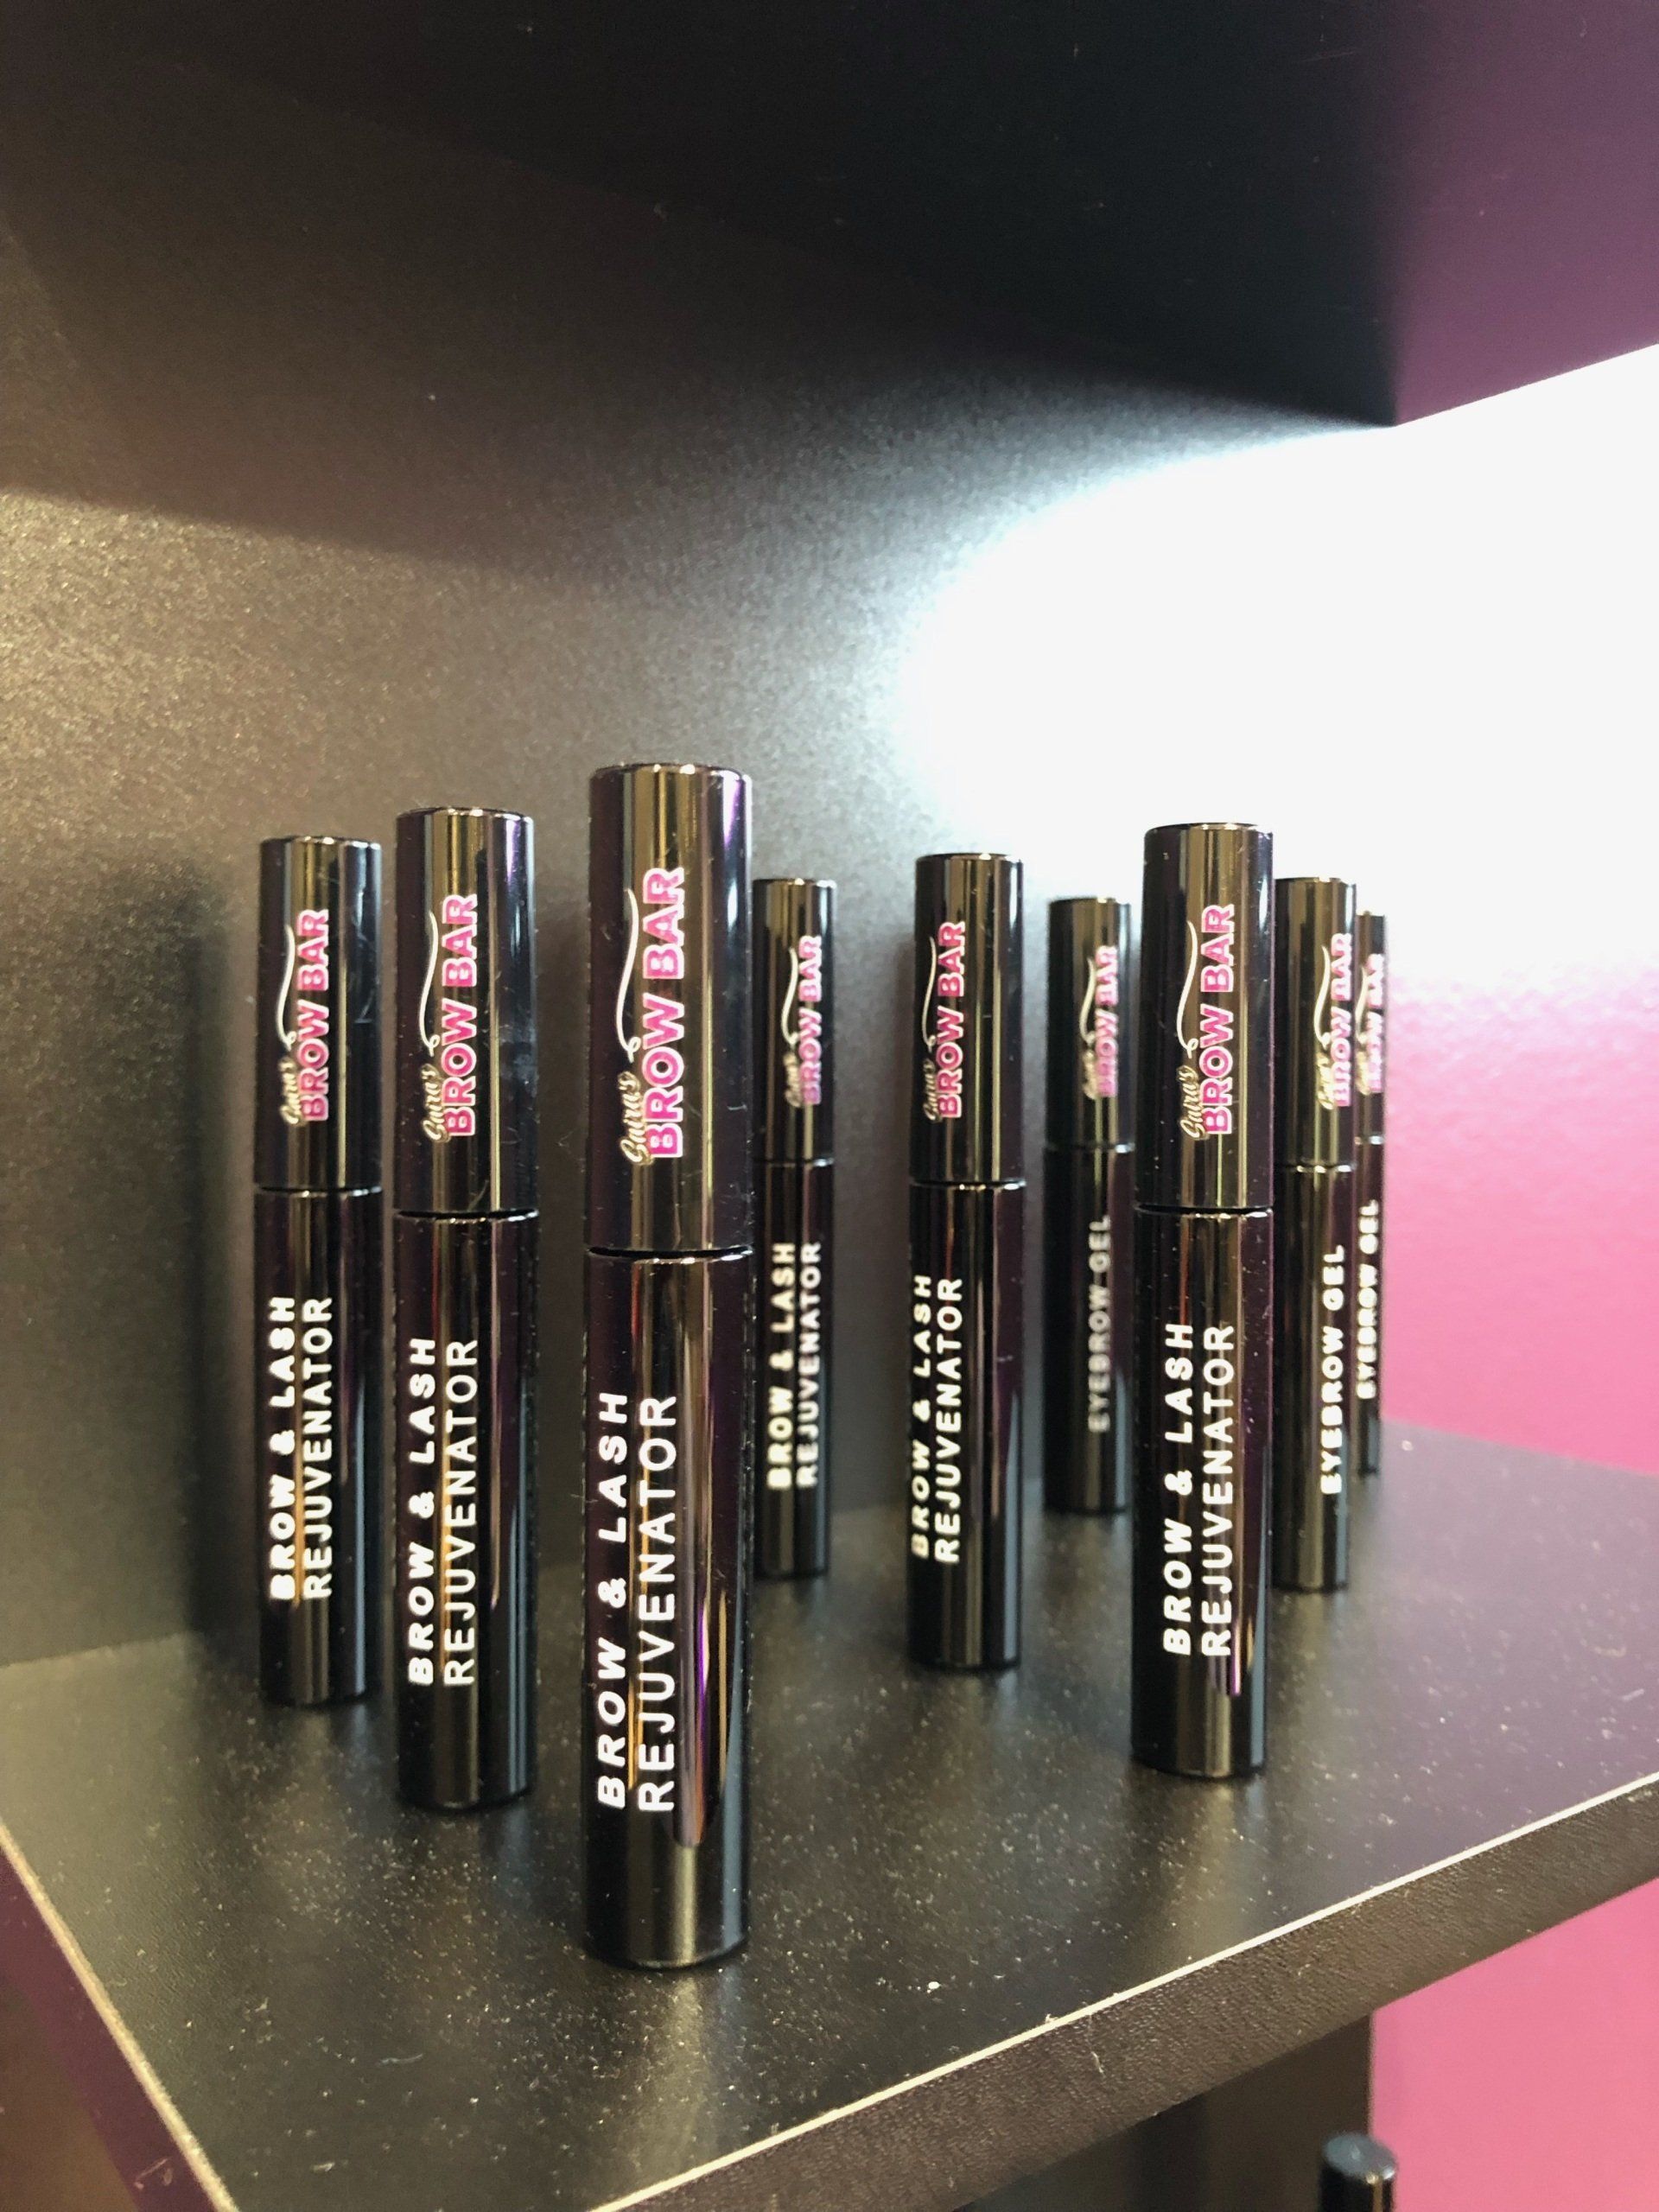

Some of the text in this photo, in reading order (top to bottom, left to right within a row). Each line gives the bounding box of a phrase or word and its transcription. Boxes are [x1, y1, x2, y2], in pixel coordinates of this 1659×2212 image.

[297, 908, 329, 1122] BROW BAR
[441, 893, 477, 1136] BROW BAR
[642, 867, 684, 1158] BROW BAR
[798, 935, 822, 1105] BROW BAR
[936, 921, 965, 1118] BROW BAR
[1199, 904, 1235, 1135] BROW BAR
[1331, 932, 1352, 1107] BROW BAR
[270, 1298, 296, 1600] BROW & LASH
[302, 1298, 333, 1599] REJUVENATOR
[767, 1243, 796, 1490] BROW & LASH
[797, 1242, 822, 1489] REJUVENATOR
[912, 1274, 931, 1559] BROW & LASH
[934, 1278, 963, 1564] REJUVENATOR
[1089, 1284, 1111, 1433] EYEBROW
[1163, 1323, 1194, 1656] BROW & LASH
[1202, 1325, 1236, 1657] REJUVENATOR
[1320, 1325, 1344, 1495] EYEBROW
[409, 1338, 435, 1685] BROW & LASH
[443, 1339, 478, 1686] REJUVENATOR
[597, 1392, 628, 1809] BROW & LASH
[639, 1395, 677, 1811] REJUVENATOR
